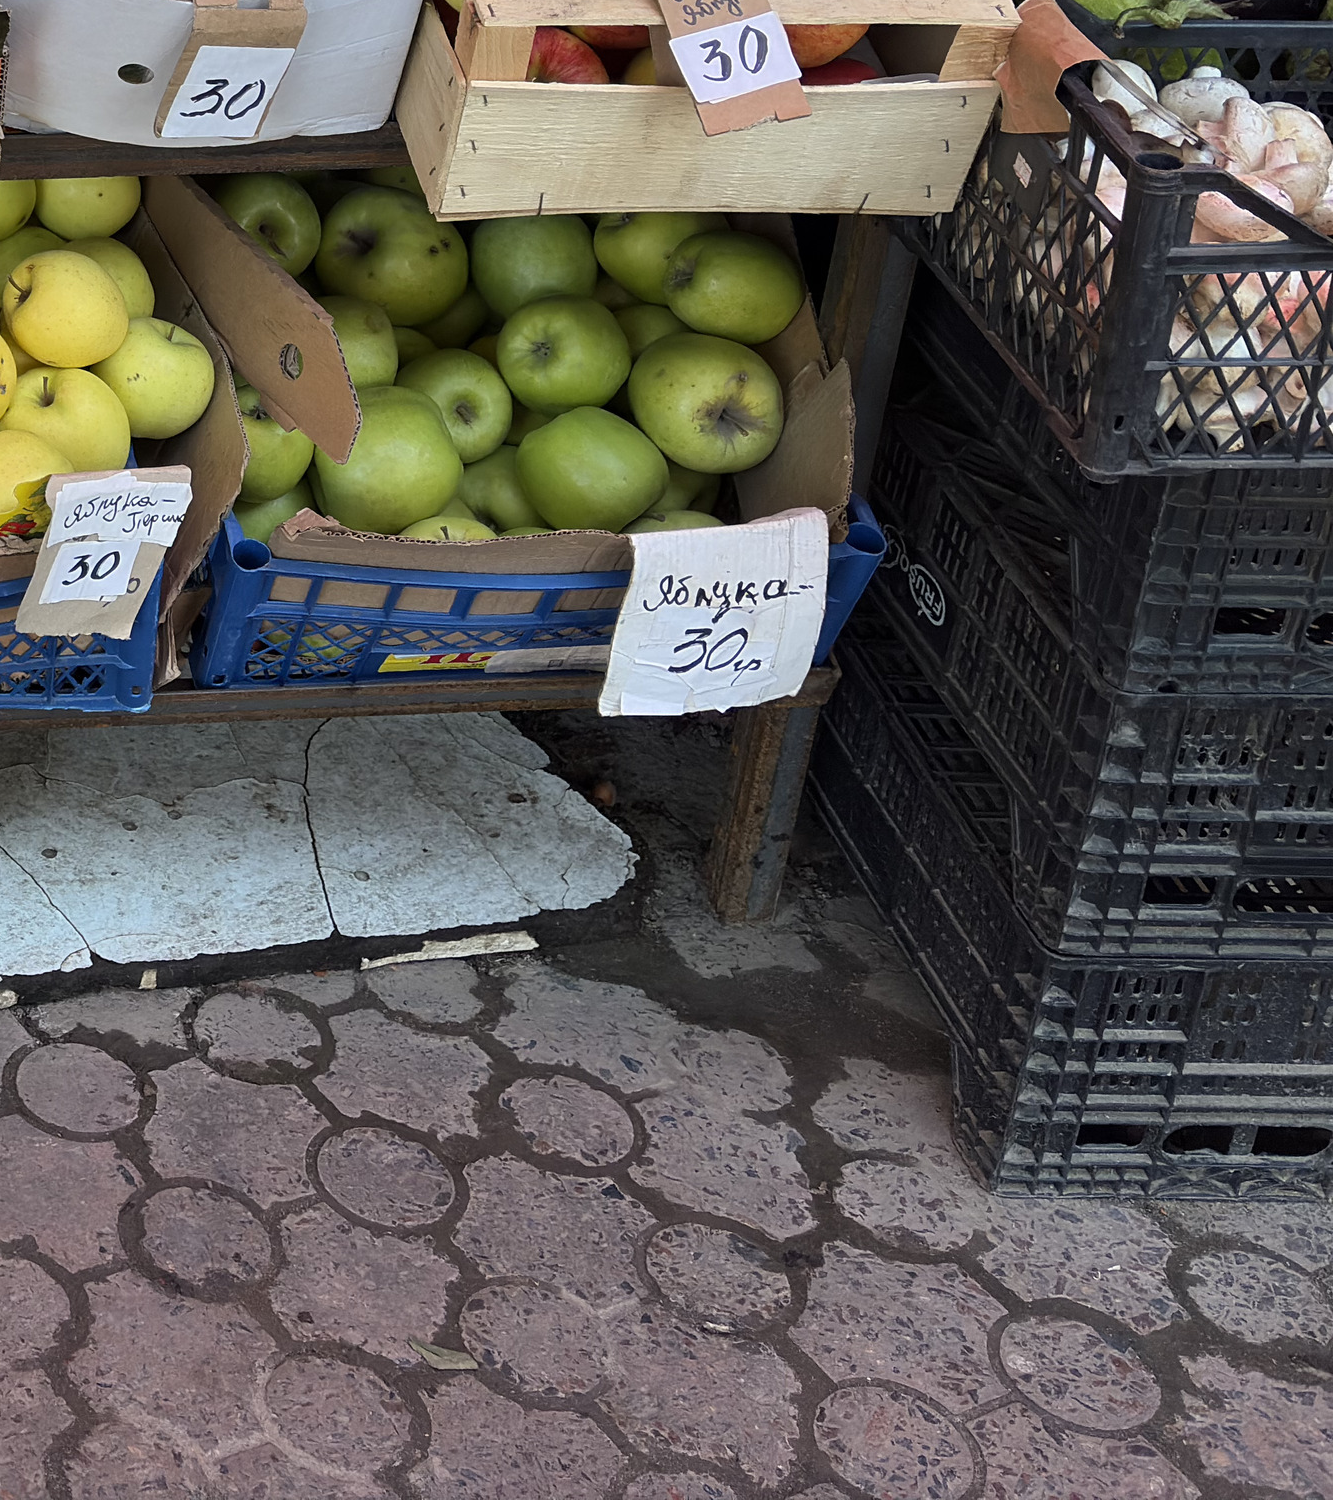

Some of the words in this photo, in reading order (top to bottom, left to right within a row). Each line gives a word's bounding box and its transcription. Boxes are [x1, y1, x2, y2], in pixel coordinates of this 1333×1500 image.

[697, 24, 771, 84] 30
[179, 77, 267, 120] 30
[61, 550, 121, 586] 30
